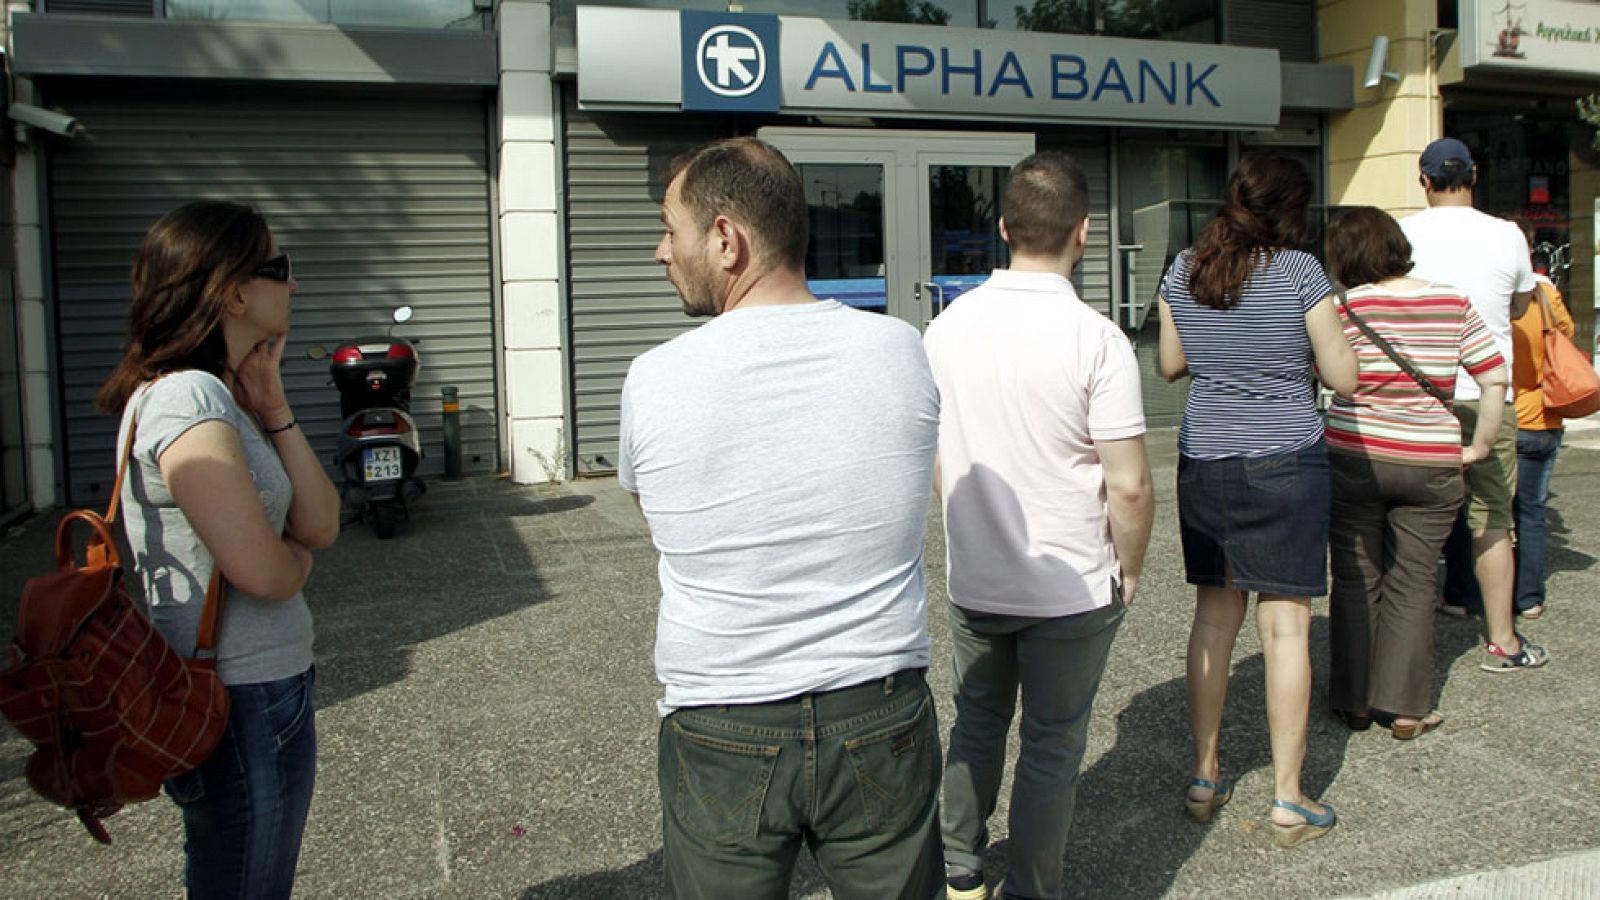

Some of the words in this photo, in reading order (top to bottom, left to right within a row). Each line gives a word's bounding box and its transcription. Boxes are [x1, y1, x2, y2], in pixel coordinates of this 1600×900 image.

[803, 41, 1033, 98] ALPHA
[1050, 53, 1221, 107] BANK
[374, 464, 399, 477] 213
